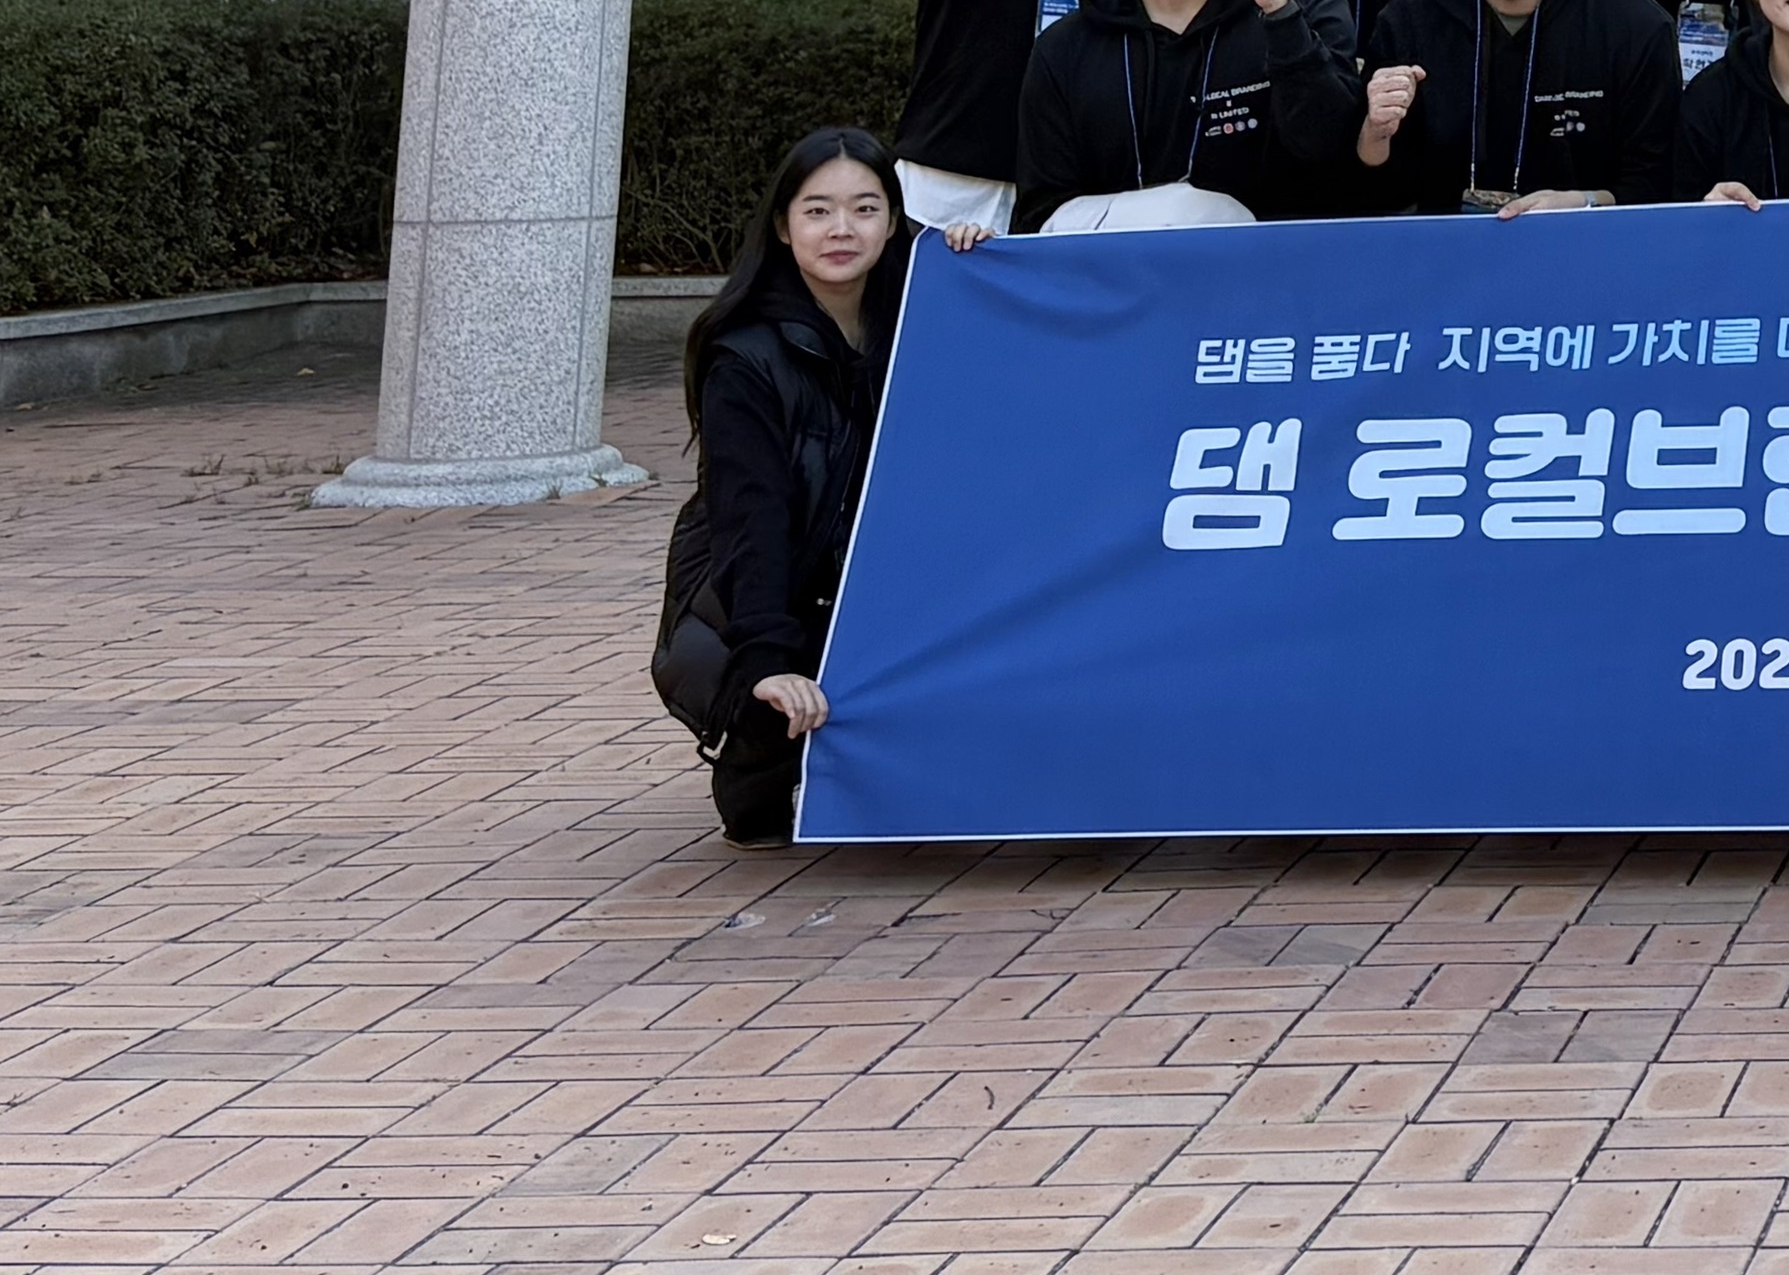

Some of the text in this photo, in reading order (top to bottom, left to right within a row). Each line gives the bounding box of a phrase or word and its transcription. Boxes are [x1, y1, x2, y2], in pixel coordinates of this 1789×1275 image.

[1196, 338, 1297, 385] 댐을
[1312, 328, 1412, 381] 품다
[1439, 327, 1596, 374] 지역에
[1609, 319, 1761, 367] 가치를
[1163, 419, 1303, 551] 댐
